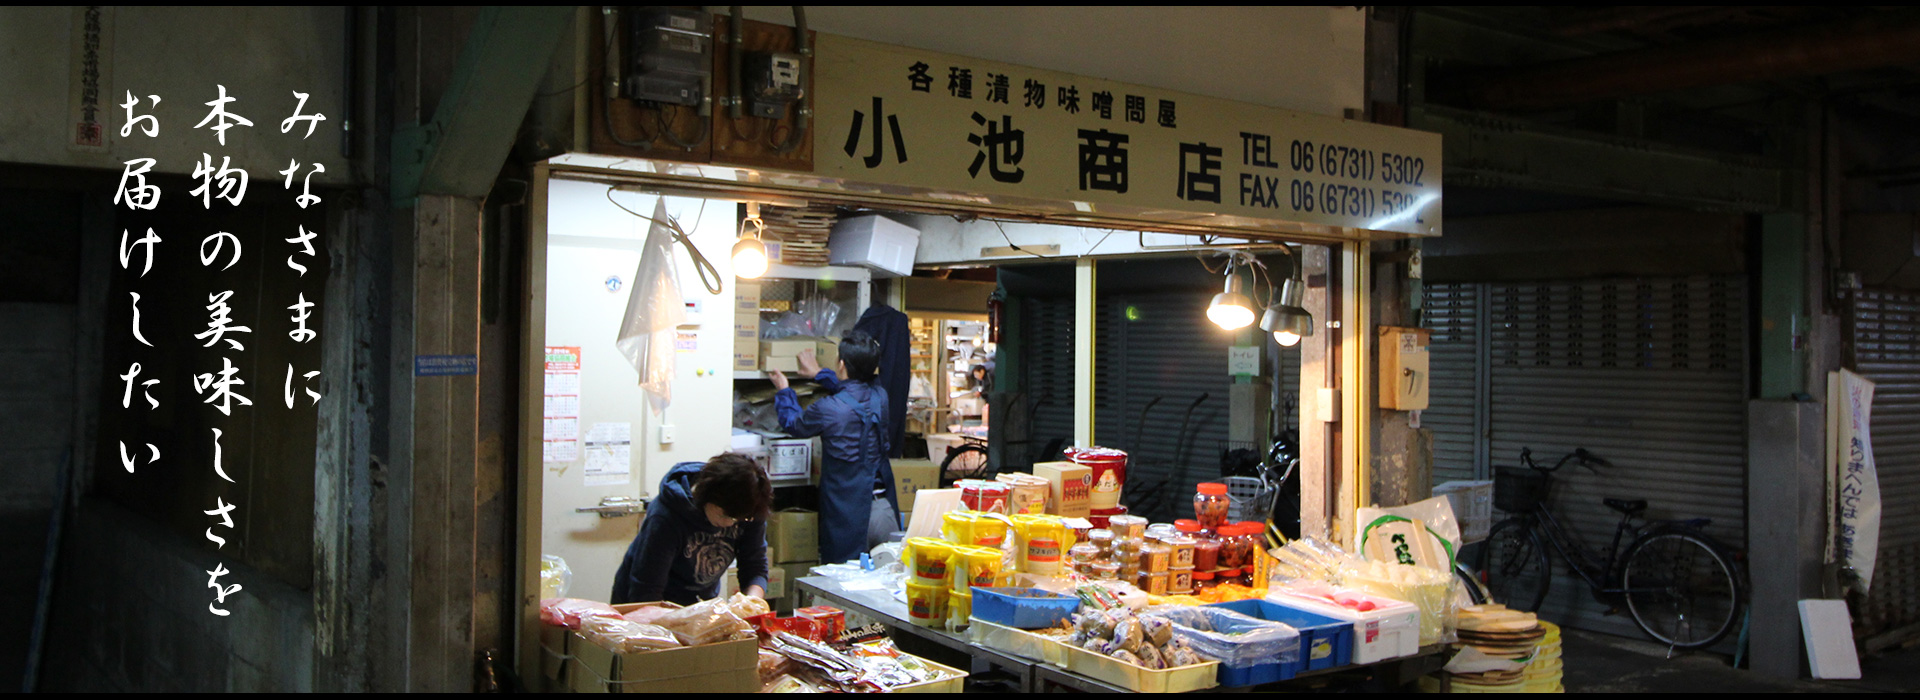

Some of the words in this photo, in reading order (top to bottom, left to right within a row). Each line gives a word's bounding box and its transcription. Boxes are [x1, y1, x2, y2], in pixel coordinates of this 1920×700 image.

[907, 61, 1177, 129] 各種漬物味噌問屋
[843, 97, 1223, 205] 小池商店
[1240, 131, 1279, 169] TEL
[1381, 152, 1424, 187] 5302
[1240, 172, 1279, 209] FAX
[1233, 351, 1254, 360] トイレ
